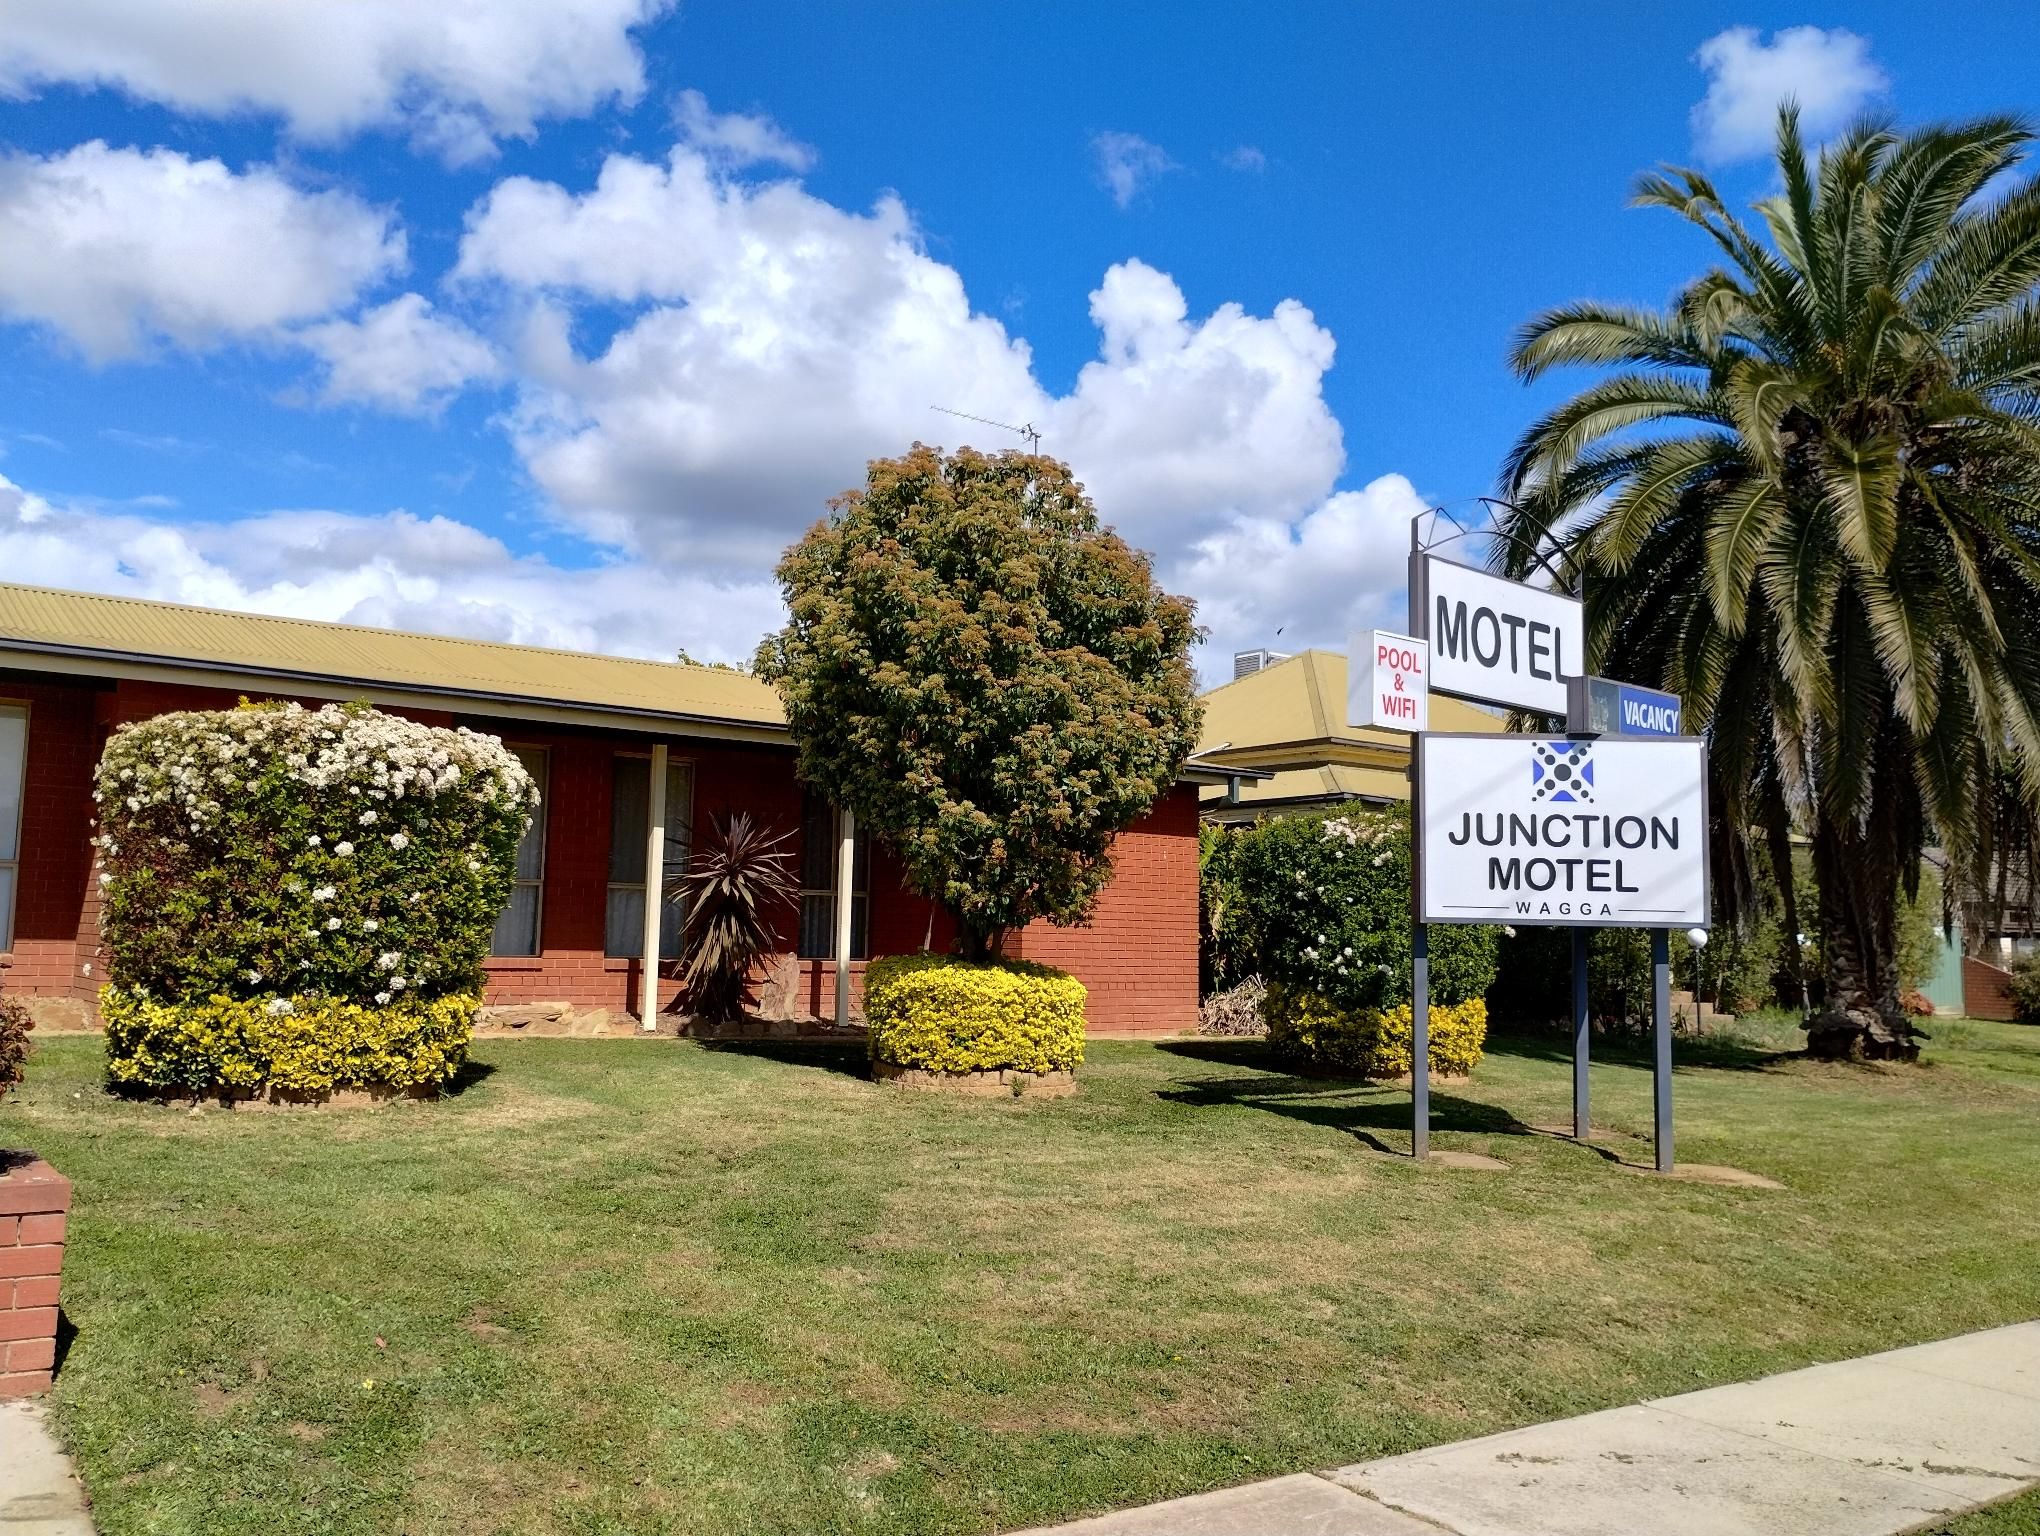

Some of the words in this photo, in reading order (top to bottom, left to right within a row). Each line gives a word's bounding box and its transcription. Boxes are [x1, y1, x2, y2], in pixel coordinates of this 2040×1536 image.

[1437, 595, 1569, 684] MOTEL
[1377, 645, 1422, 674] POOL
[1394, 673, 1404, 692] &
[1382, 693, 1416, 720] WIFI
[1624, 699, 1679, 734] VACANCY
[1449, 813, 1679, 849] JUNCTION
[1488, 857, 1639, 892] MOTEL
[1516, 902, 1611, 916] WAGGA
